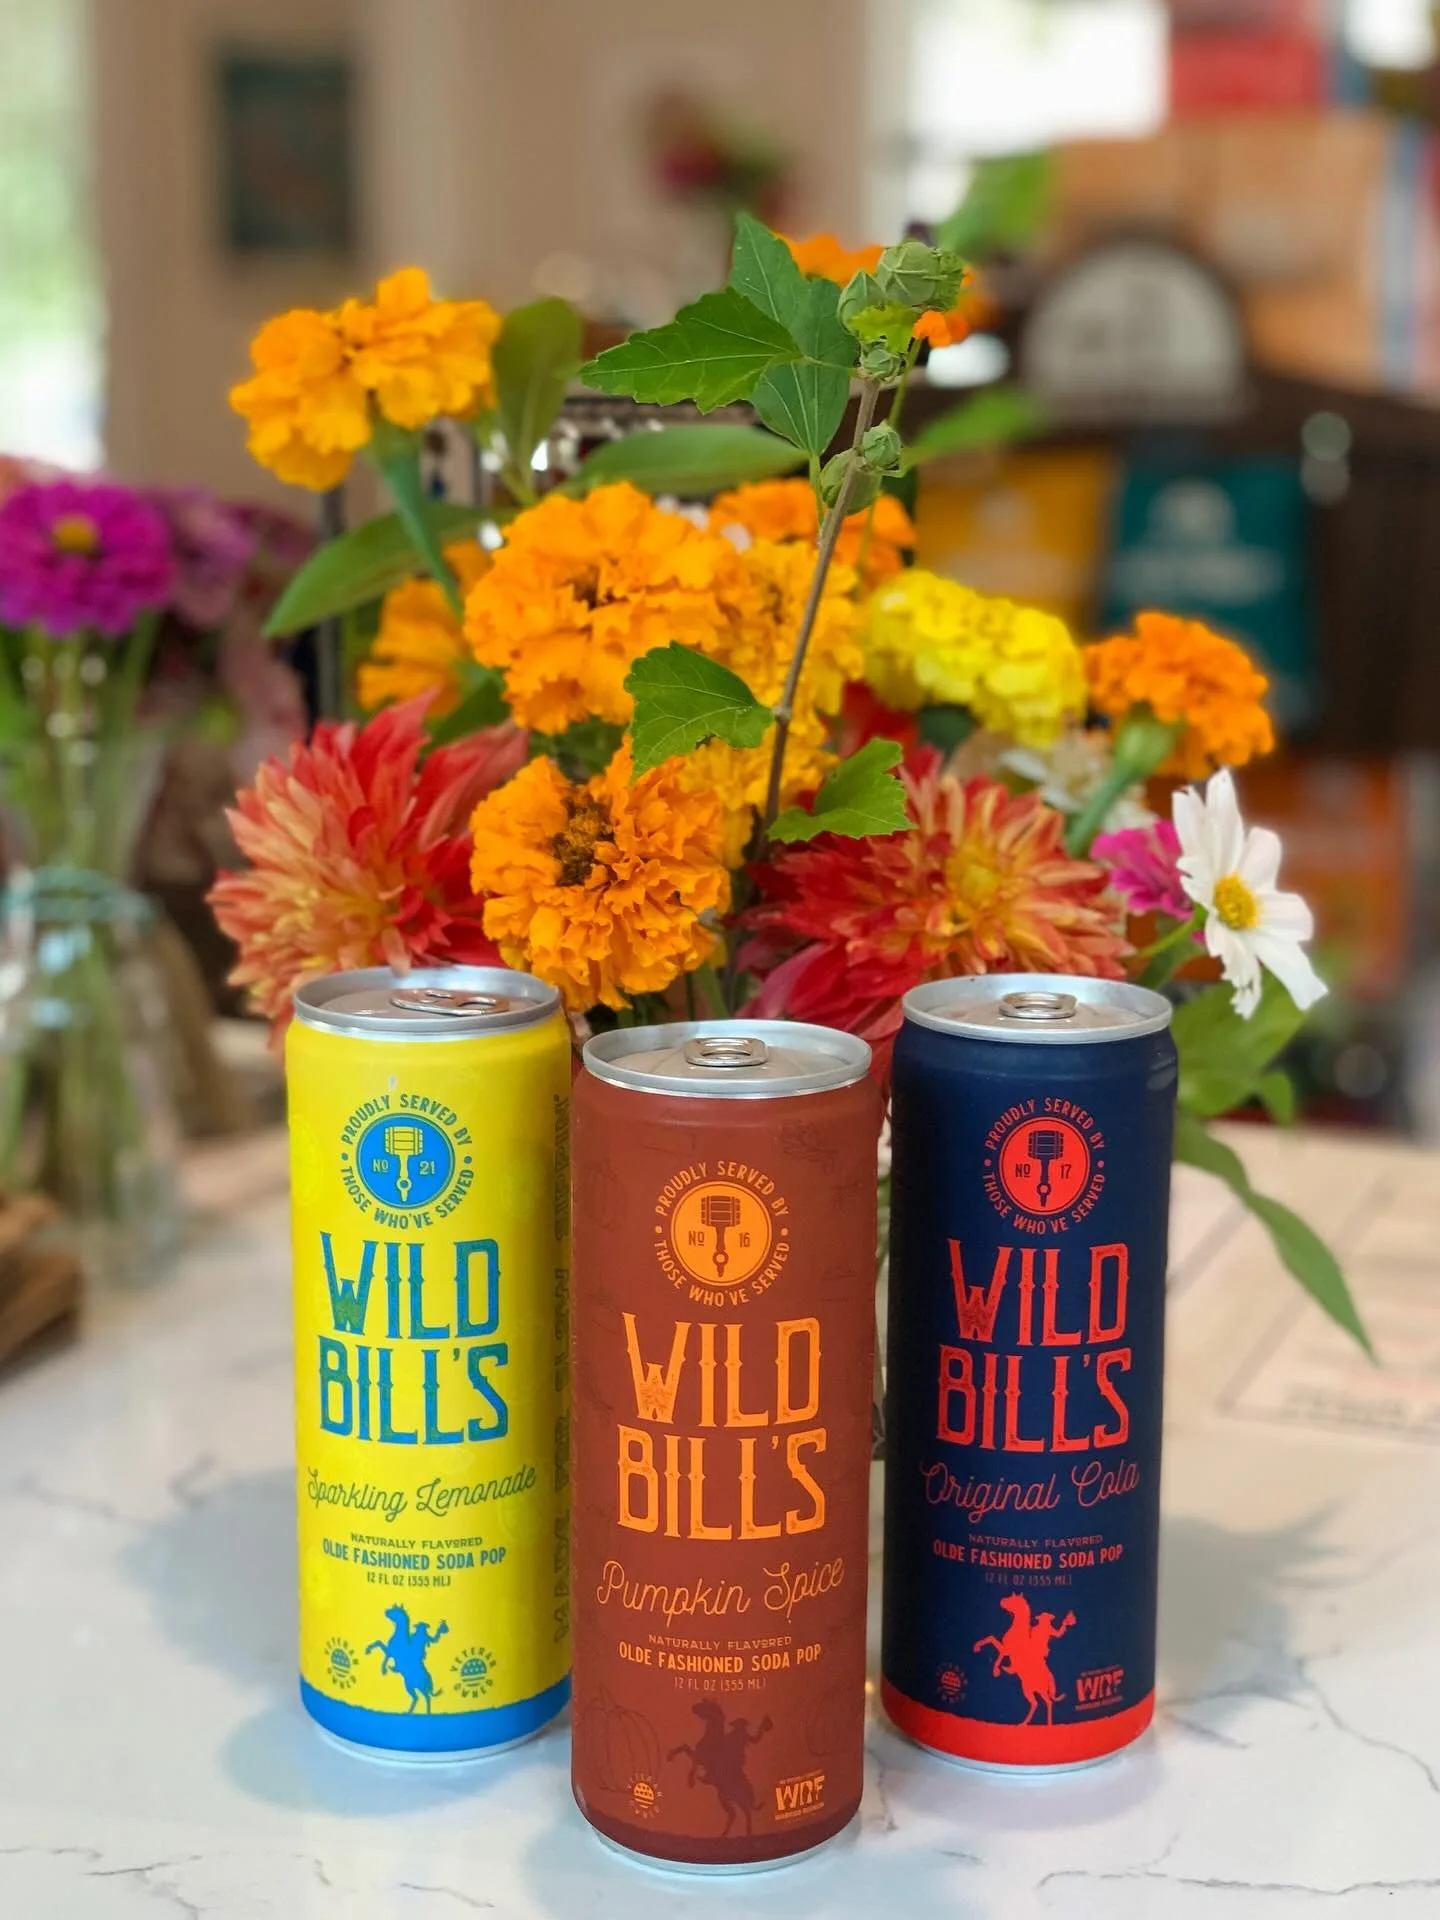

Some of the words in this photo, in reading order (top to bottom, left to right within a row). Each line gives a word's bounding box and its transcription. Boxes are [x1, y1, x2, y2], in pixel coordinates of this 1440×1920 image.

[341, 1094, 390, 1145] PROUDLY
[400, 1094, 457, 1126] SERVED
[454, 1127, 472, 1145] BY
[985, 1099, 1036, 1151] PROUDLY
[1044, 1097, 1094, 1130] SERVED
[1089, 1132, 1105, 1149] BY
[419, 1160, 435, 1175] 21
[655, 1162, 707, 1217] PROUDLY
[717, 1160, 775, 1195] SERVED
[772, 1197, 789, 1217] BY
[1060, 1164, 1072, 1179] 17
[341, 1166, 372, 1213] THOSE
[374, 1207, 433, 1229] WHO'VE
[435, 1169, 474, 1218] SERVED
[983, 1172, 1012, 1218] THOSE
[1013, 1214, 1069, 1235] WHO'VE
[1072, 1174, 1105, 1223] SERVED
[739, 1232, 750, 1248] 16
[320, 1231, 501, 1339] WILD
[654, 1240, 687, 1289] THOSE
[689, 1285, 750, 1307] WHO'VE
[752, 1242, 790, 1295] SERVED
[948, 1238, 1129, 1346] WILD
[318, 1335, 509, 1445] BILL'S
[622, 1312, 821, 1427] WILD
[936, 1343, 1132, 1453] BILL'S
[307, 1466, 408, 1522] Sparkling
[416, 1464, 536, 1517] Lemonade
[617, 1423, 827, 1540] BILL'S
[919, 1458, 1061, 1524] Original
[1071, 1458, 1141, 1508] Cola
[323, 1538, 349, 1561] OLDE
[353, 1547, 430, 1570] FASHIONED
[436, 1551, 474, 1570] SODA
[480, 1546, 506, 1566] POP
[351, 1532, 416, 1549] NATURALLY
[422, 1536, 483, 1550] FLAVORED
[934, 1539, 965, 1562] OLDE
[970, 1550, 1052, 1570] FASHIONED
[1059, 1552, 1094, 1569] SODA
[1100, 1544, 1123, 1564] POP
[969, 1533, 1038, 1548] NATURALLY
[1045, 1534, 1103, 1548] FLAVORED
[367, 1572, 375, 1583] 12
[379, 1573, 389, 1585] FL
[392, 1574, 404, 1586] OZ
[597, 1561, 751, 1627] Pumpkin
[762, 1557, 845, 1624] Spice
[450, 1646, 497, 1673] VETERAN
[619, 1641, 652, 1666] OLDE
[657, 1651, 744, 1673] FASHIONED
[751, 1653, 790, 1672] SODA
[797, 1643, 822, 1665] POP
[648, 1634, 720, 1650] NATURALLY
[728, 1635, 792, 1651] FLAVORED
[674, 1676, 683, 1689] 12
[688, 1678, 699, 1691] FL
[704, 1679, 716, 1691] OZ
